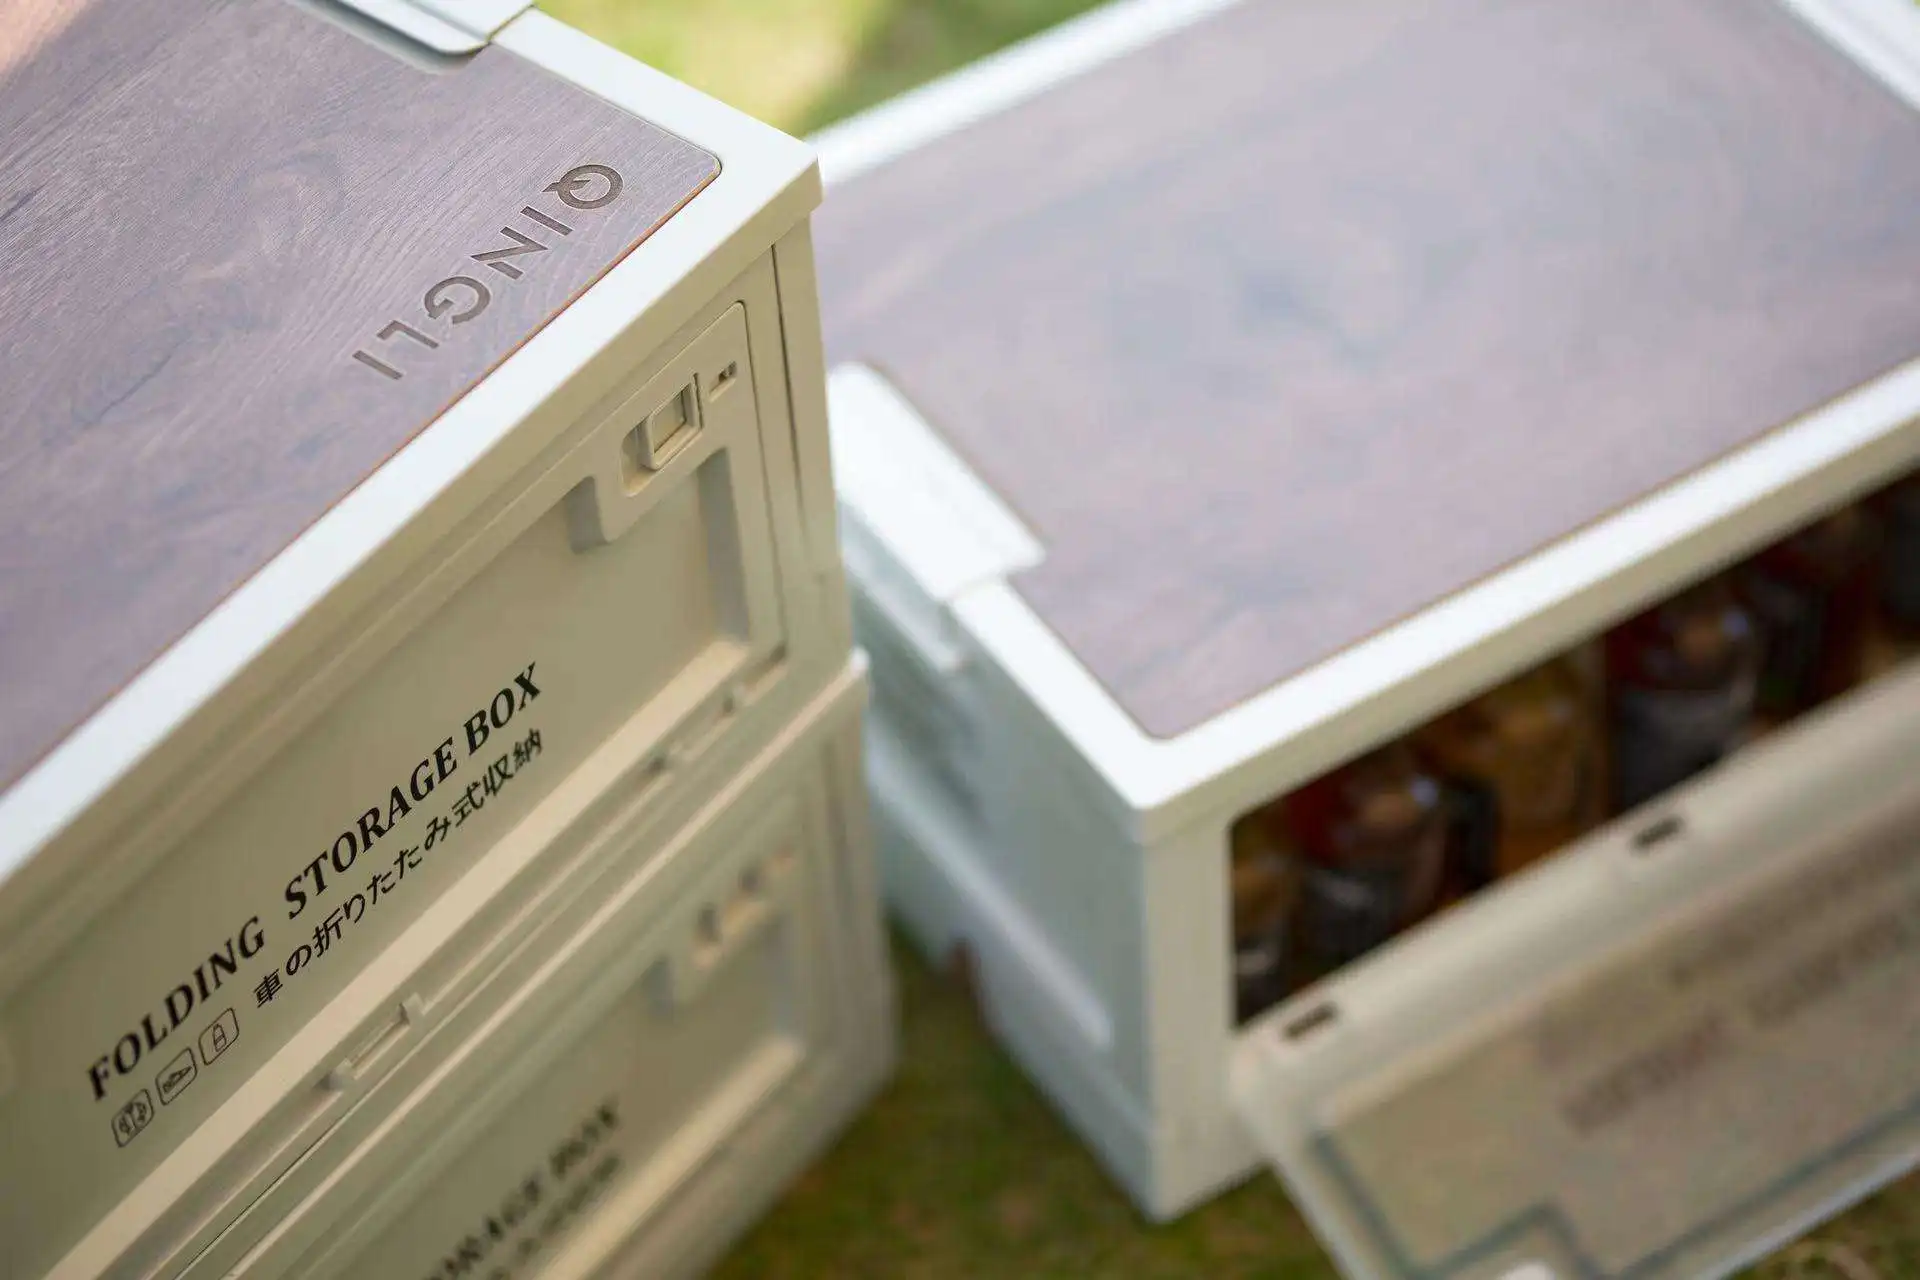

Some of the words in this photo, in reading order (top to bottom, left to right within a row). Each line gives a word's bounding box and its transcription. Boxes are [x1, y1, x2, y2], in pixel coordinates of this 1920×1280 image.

[353, 163, 624, 381] QINGLI
[86, 916, 265, 1102] FOLDING
[284, 737, 458, 920] STORAGE
[462, 662, 543, 756] BOX
[253, 728, 543, 1008] 車の折りたたみ式収納
